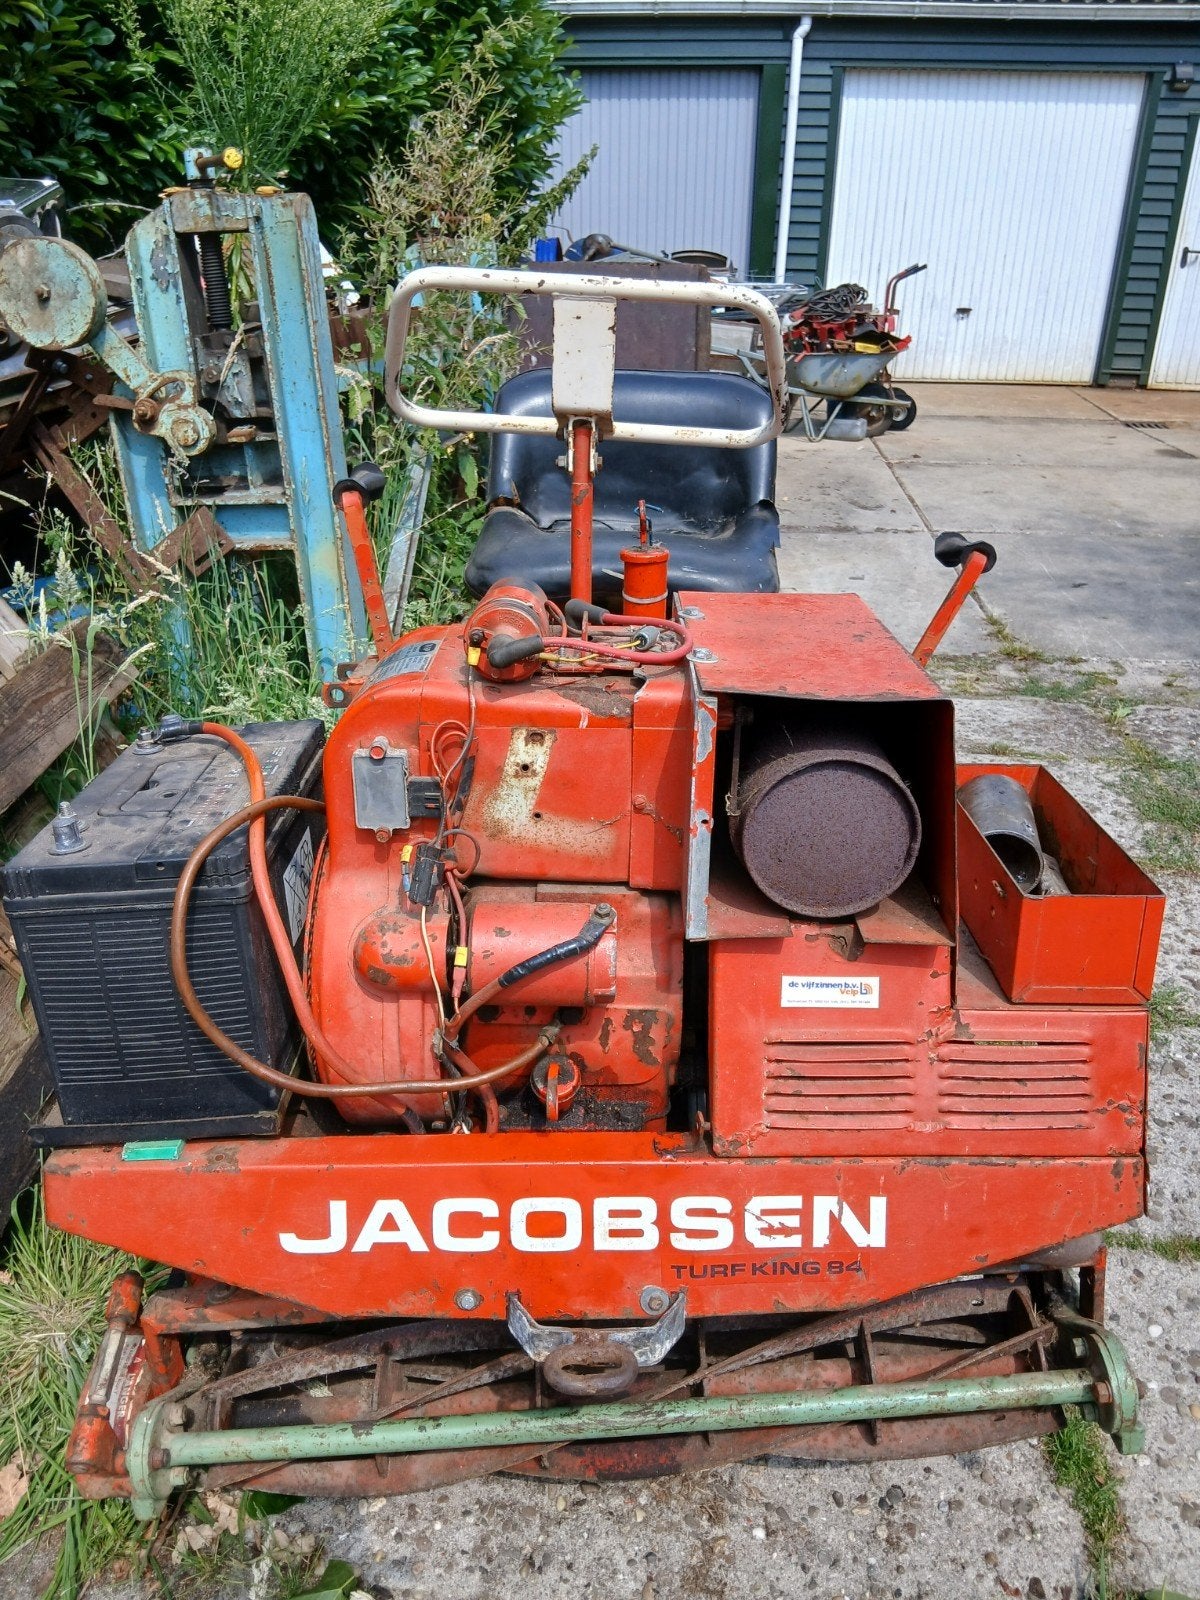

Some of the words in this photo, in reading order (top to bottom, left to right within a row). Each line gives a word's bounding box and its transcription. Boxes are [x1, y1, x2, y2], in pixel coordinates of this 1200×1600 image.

[279, 1196, 887, 1254] JACOBSEN
[671, 1263, 746, 1279] TURF
[751, 1260, 821, 1276] KING
[826, 1260, 862, 1275] 84
